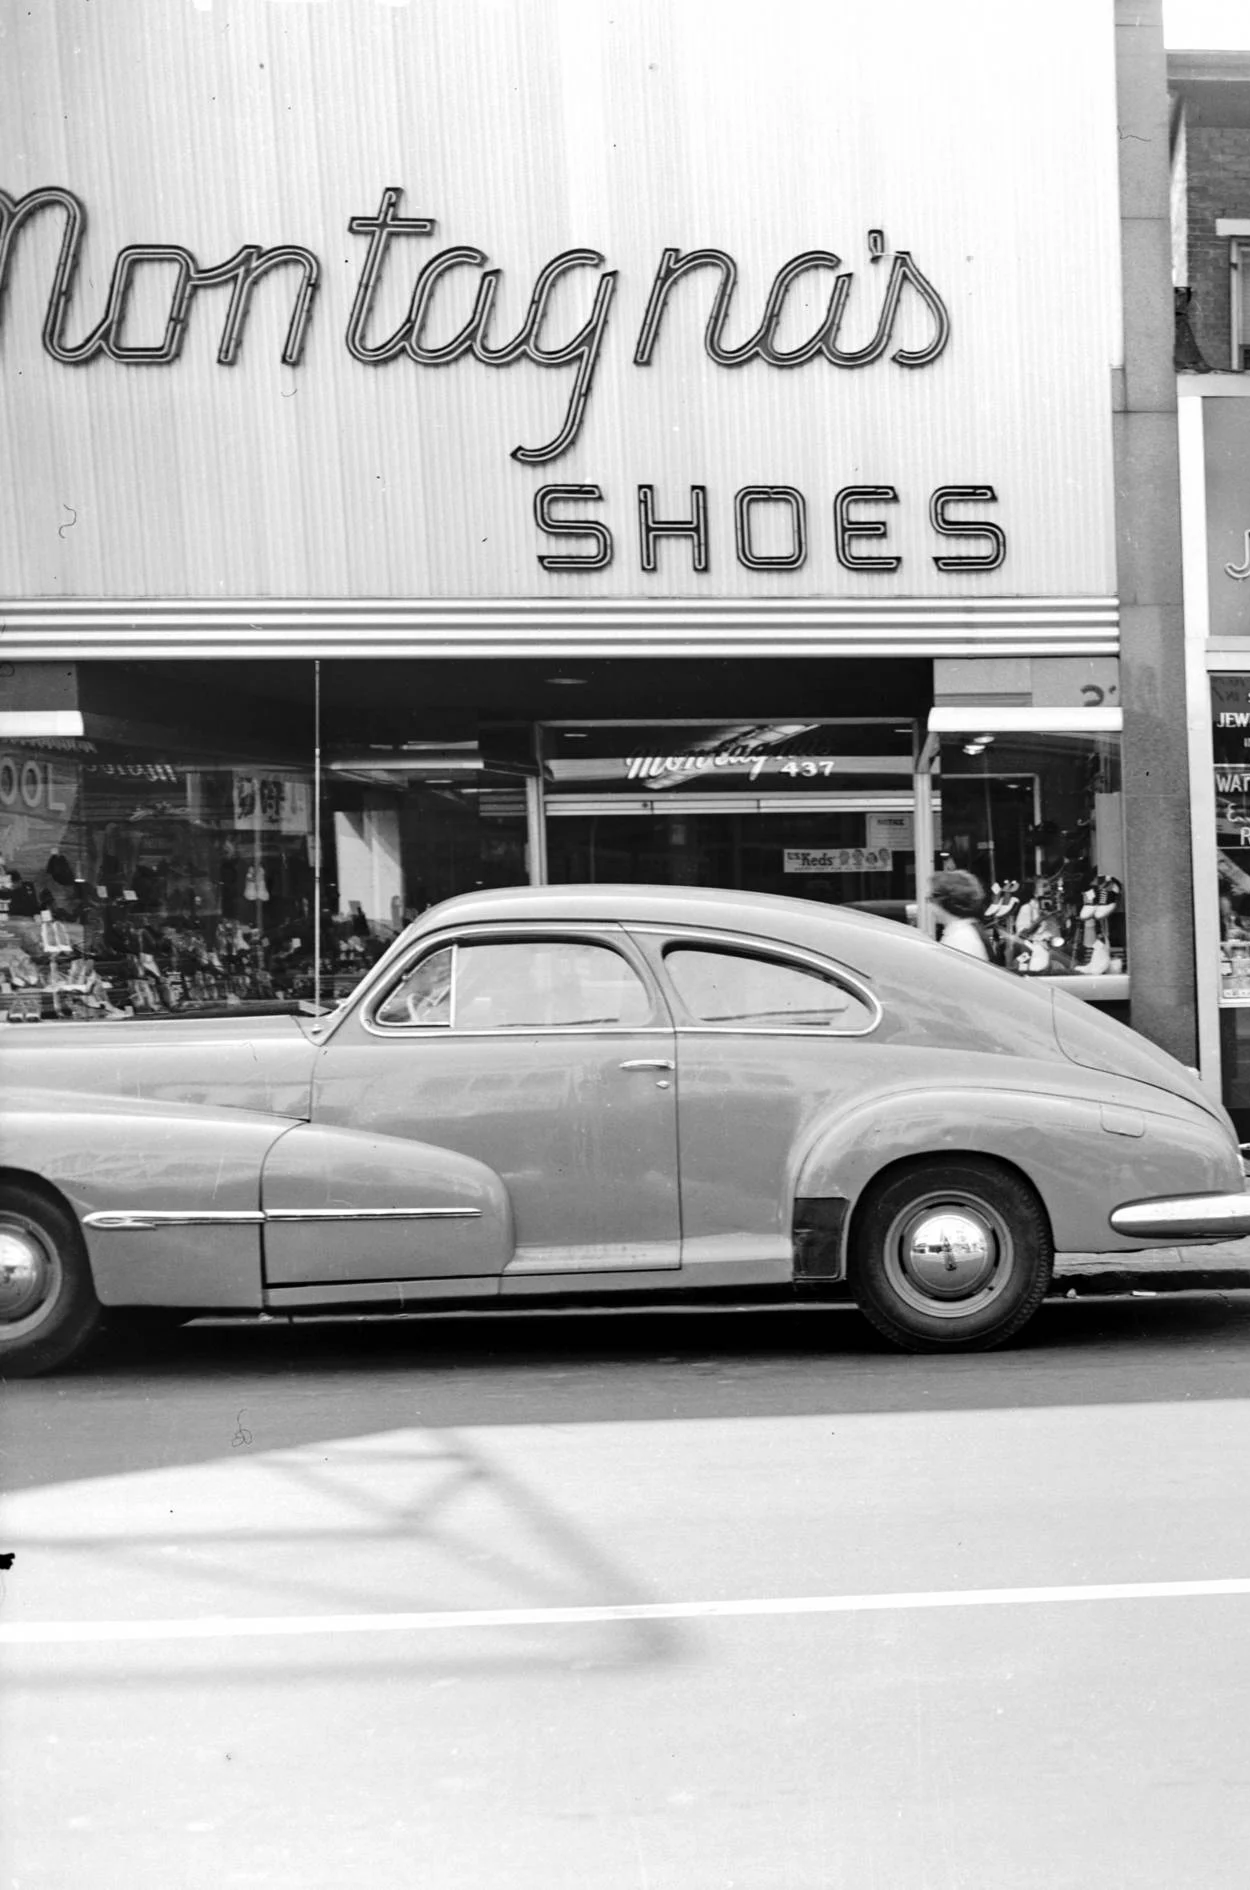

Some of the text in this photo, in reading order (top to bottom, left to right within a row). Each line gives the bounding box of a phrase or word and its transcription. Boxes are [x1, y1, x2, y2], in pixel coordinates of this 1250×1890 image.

[0, 186, 950, 465] Montagna's
[533, 484, 1007, 573] SHOES
[779, 761, 835, 777] 437
[1226, 802, 1246, 823] &
[801, 851, 834, 867] Keds
